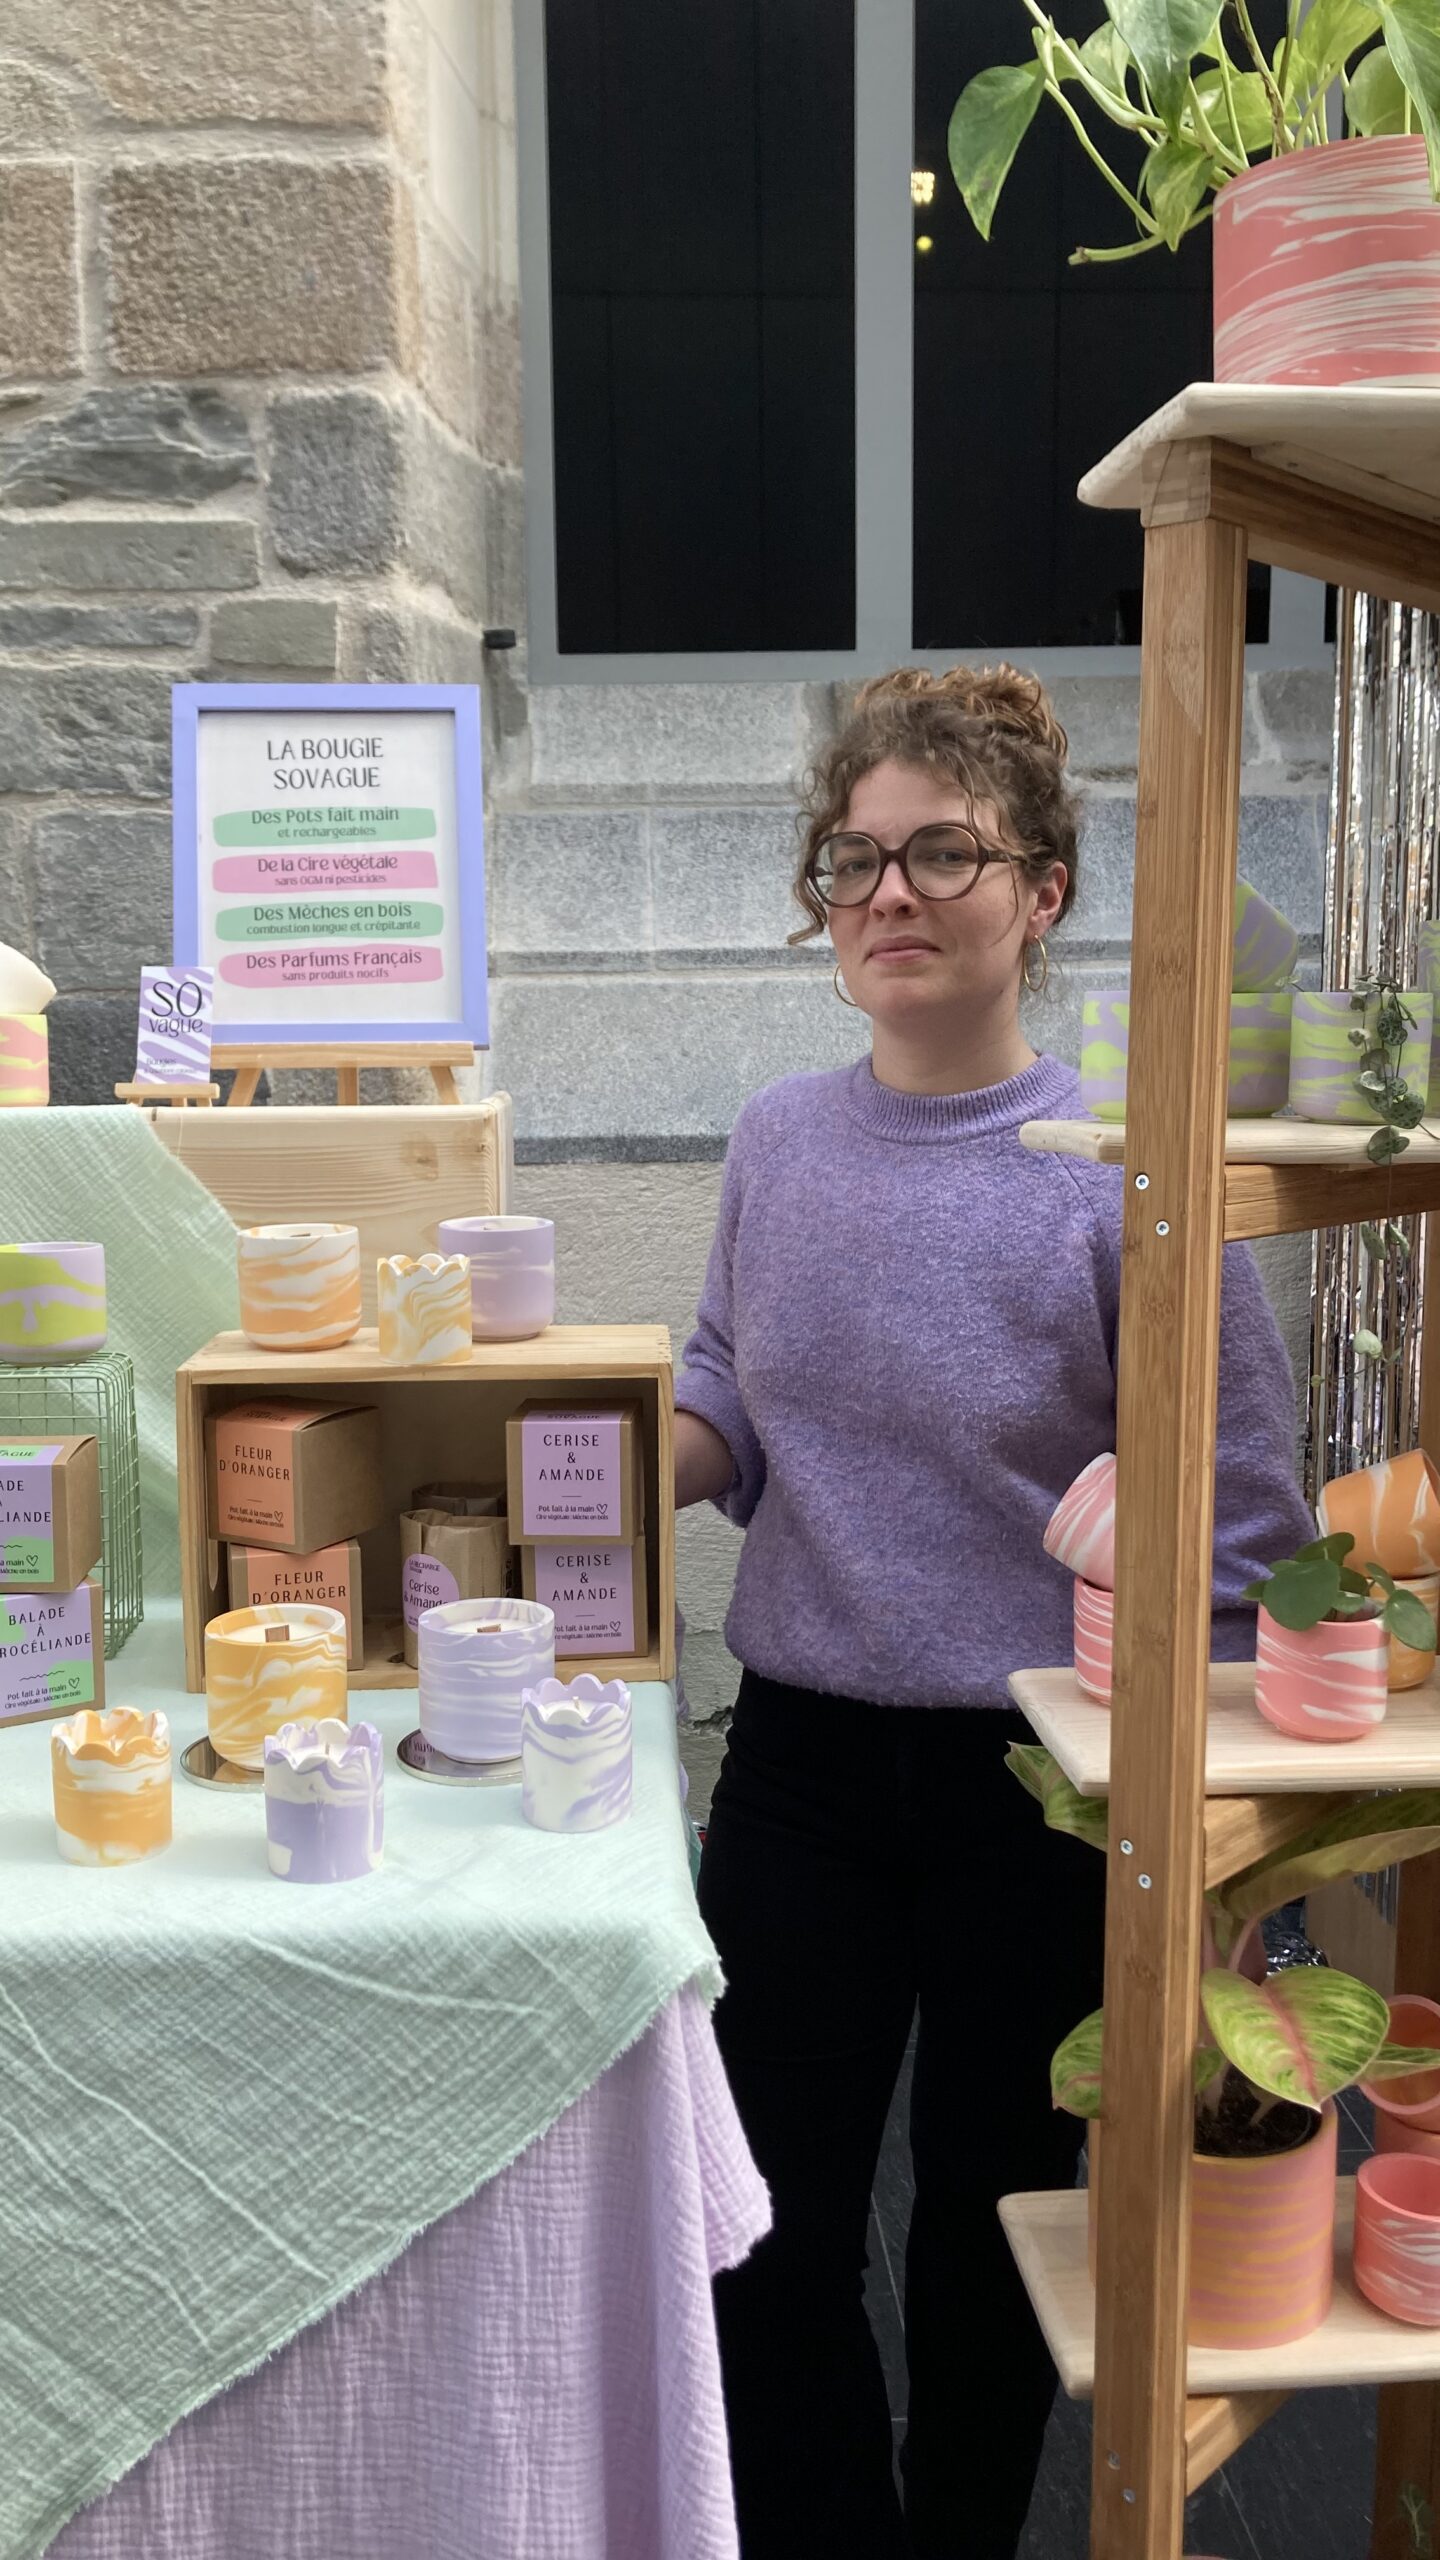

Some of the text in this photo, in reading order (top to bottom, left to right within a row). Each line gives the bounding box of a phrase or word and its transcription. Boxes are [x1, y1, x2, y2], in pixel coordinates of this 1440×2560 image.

[267, 737, 384, 761] LA BOUGIE
[273, 767, 381, 790] SOVAGUE
[252, 806, 400, 824] Des Pots fait main
[277, 826, 377, 839] et rechargeables
[258, 855, 398, 873] De la Cire végétale
[275, 874, 387, 886] sans OGM ni pesticides
[253, 902, 412, 921] Des Mèches en bois
[246, 920, 421, 935] combustion longue et crépitante
[246, 949, 422, 969] Des Parfums Français
[282, 968, 389, 982] sans produits nocifs
[151, 981, 202, 1017] SO
[149, 1018, 203, 1038] vague
[543, 1434, 599, 1447] CERISE
[235, 1445, 272, 1461] FLEUR
[567, 1451, 576, 1464] &
[219, 1460, 290, 1481] D'ORANGER
[539, 1469, 604, 1481] AMANDE
[556, 1554, 612, 1568] CERISE
[275, 1571, 324, 1586] FLEUR
[580, 1571, 589, 1584] &
[252, 1586, 346, 1605] D'ORANGER
[409, 1579, 440, 1596] Cerise
[552, 1588, 617, 1601] AMANDE
[8, 1606, 66, 1626] BALADE
[37, 1624, 45, 1637] À
